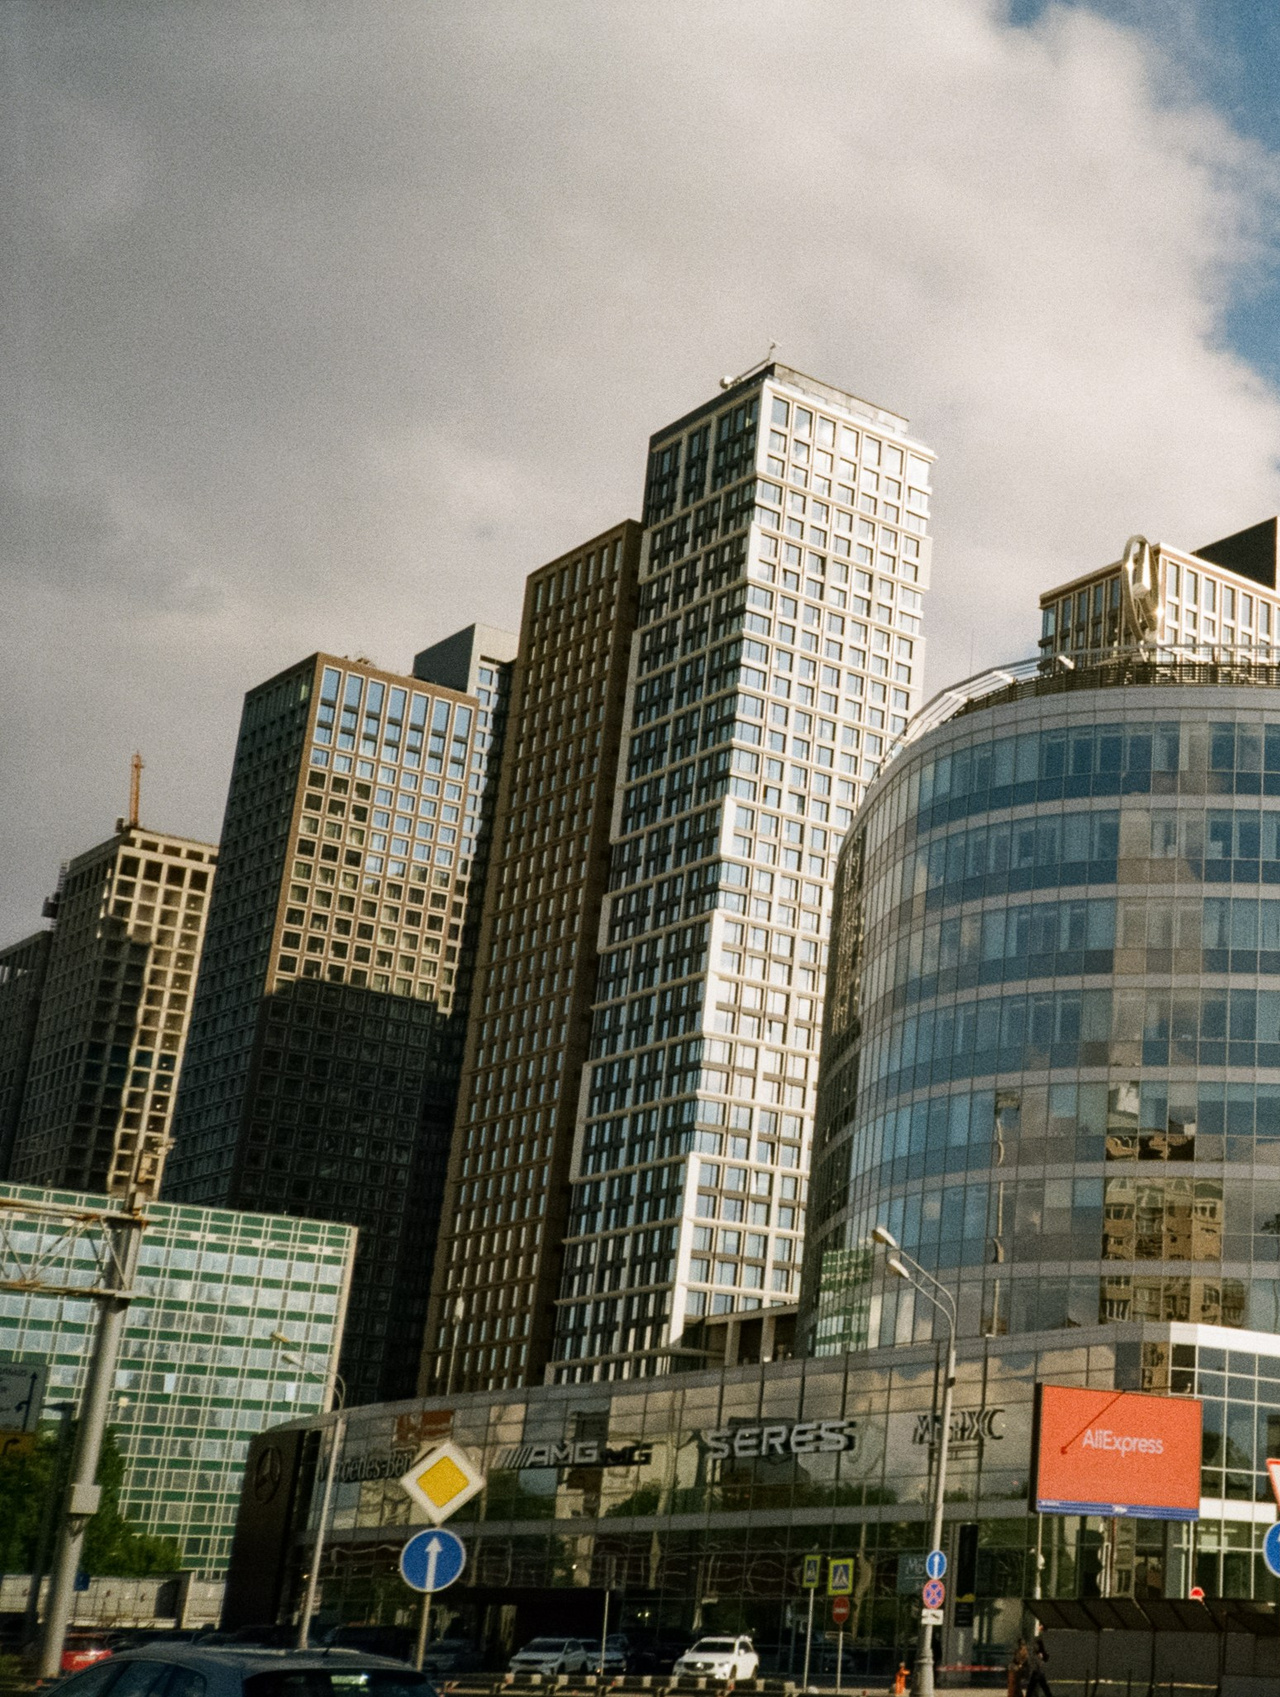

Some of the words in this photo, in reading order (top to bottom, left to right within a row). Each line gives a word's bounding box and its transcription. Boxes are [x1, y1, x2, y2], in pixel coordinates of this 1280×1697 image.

[701, 1419, 851, 1459] SERES
[1081, 1429, 1164, 1457] AliExpress
[527, 1440, 599, 1468] AMG
